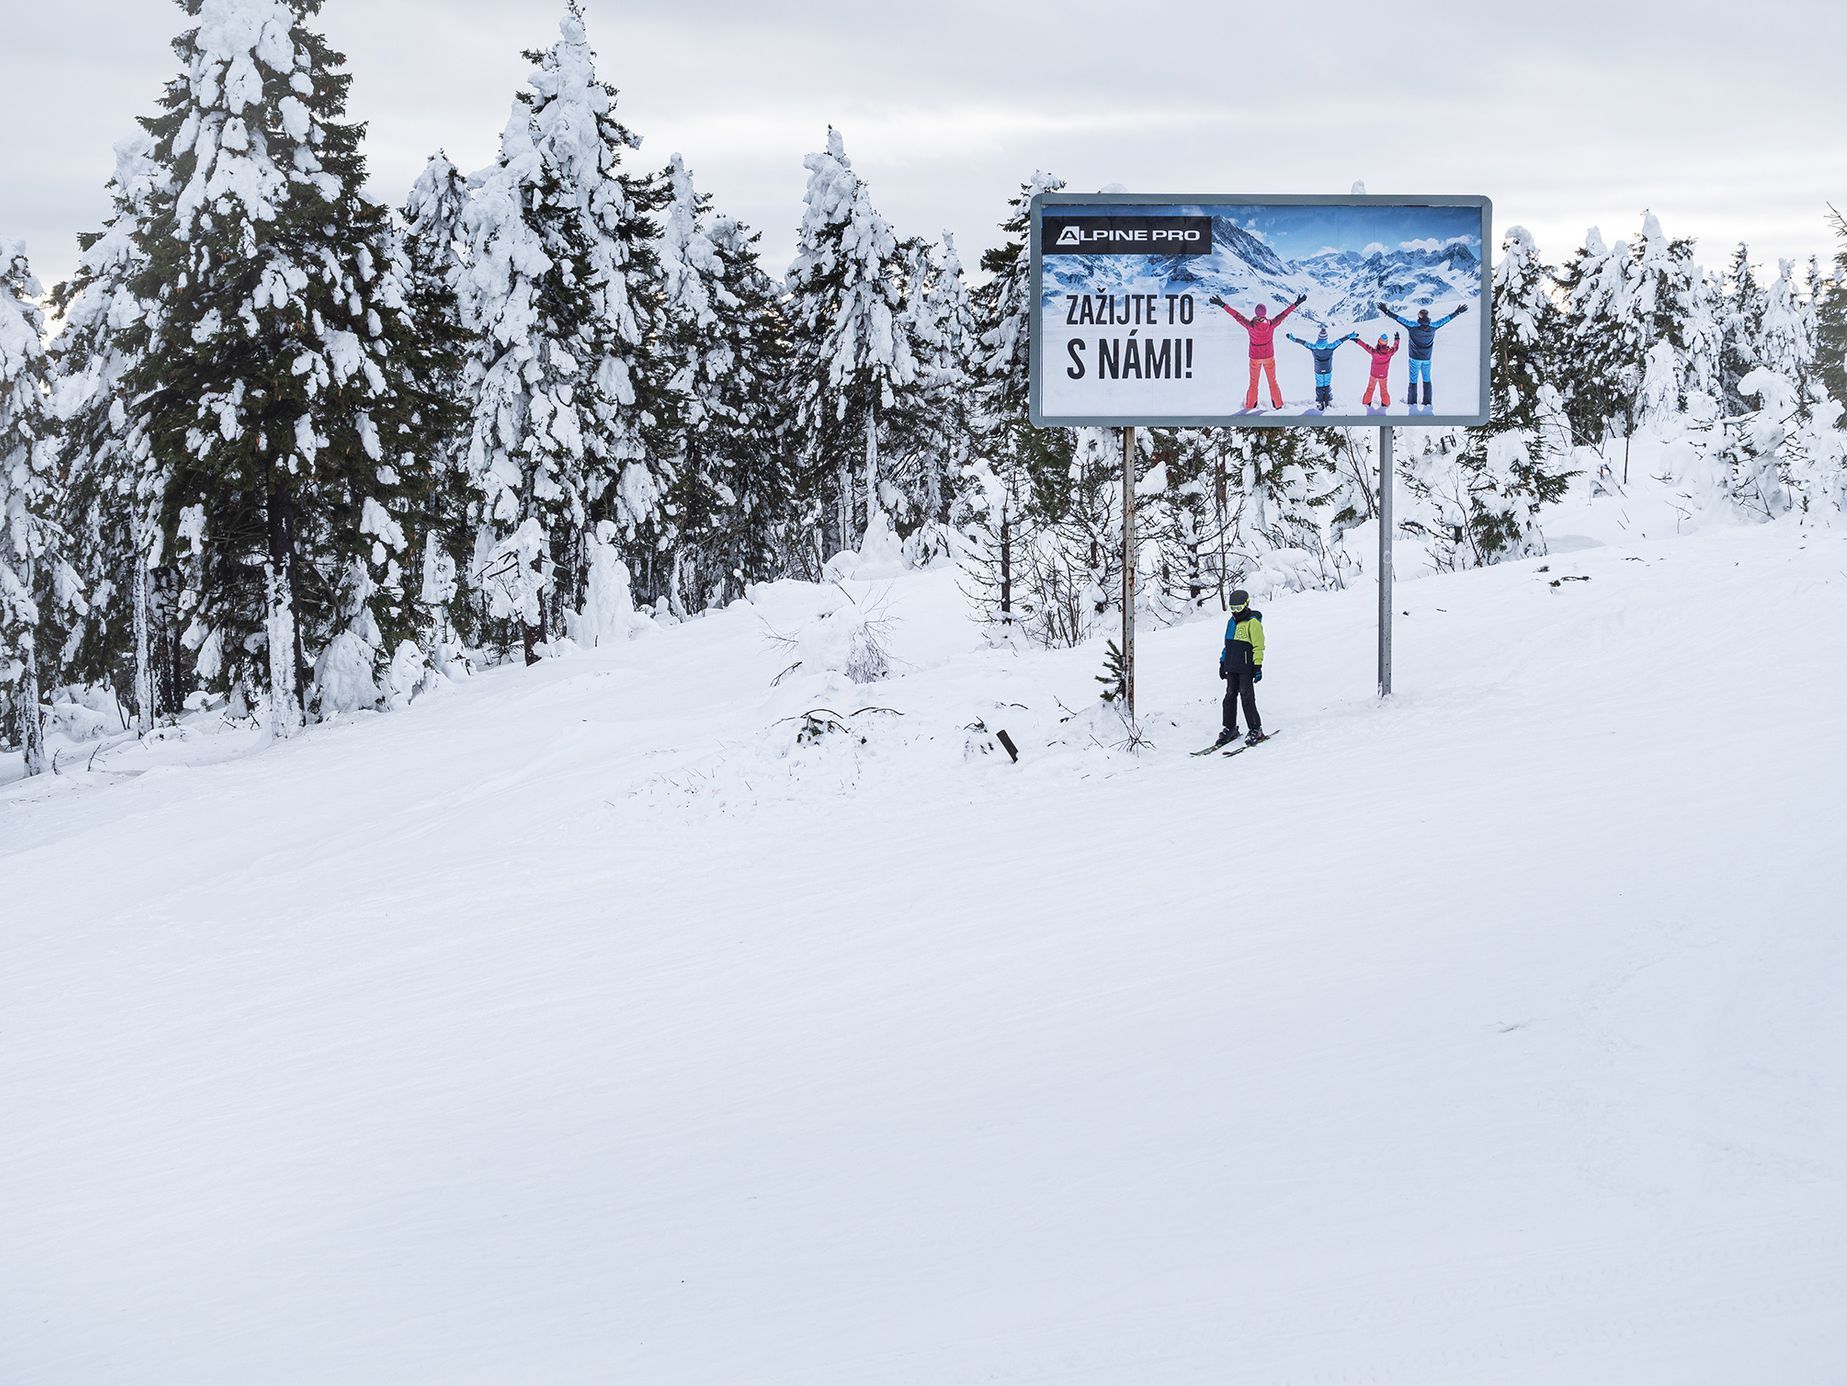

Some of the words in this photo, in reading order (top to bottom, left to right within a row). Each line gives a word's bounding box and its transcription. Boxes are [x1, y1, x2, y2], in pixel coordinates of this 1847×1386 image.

[1055, 226, 1148, 245] ALPINE
[1152, 230, 1201, 241] PRO
[1066, 288, 1158, 325] ZAŽIJTE
[1165, 294, 1194, 325] TO
[1067, 338, 1086, 380] S
[1098, 329, 1193, 379] NÁMI!
